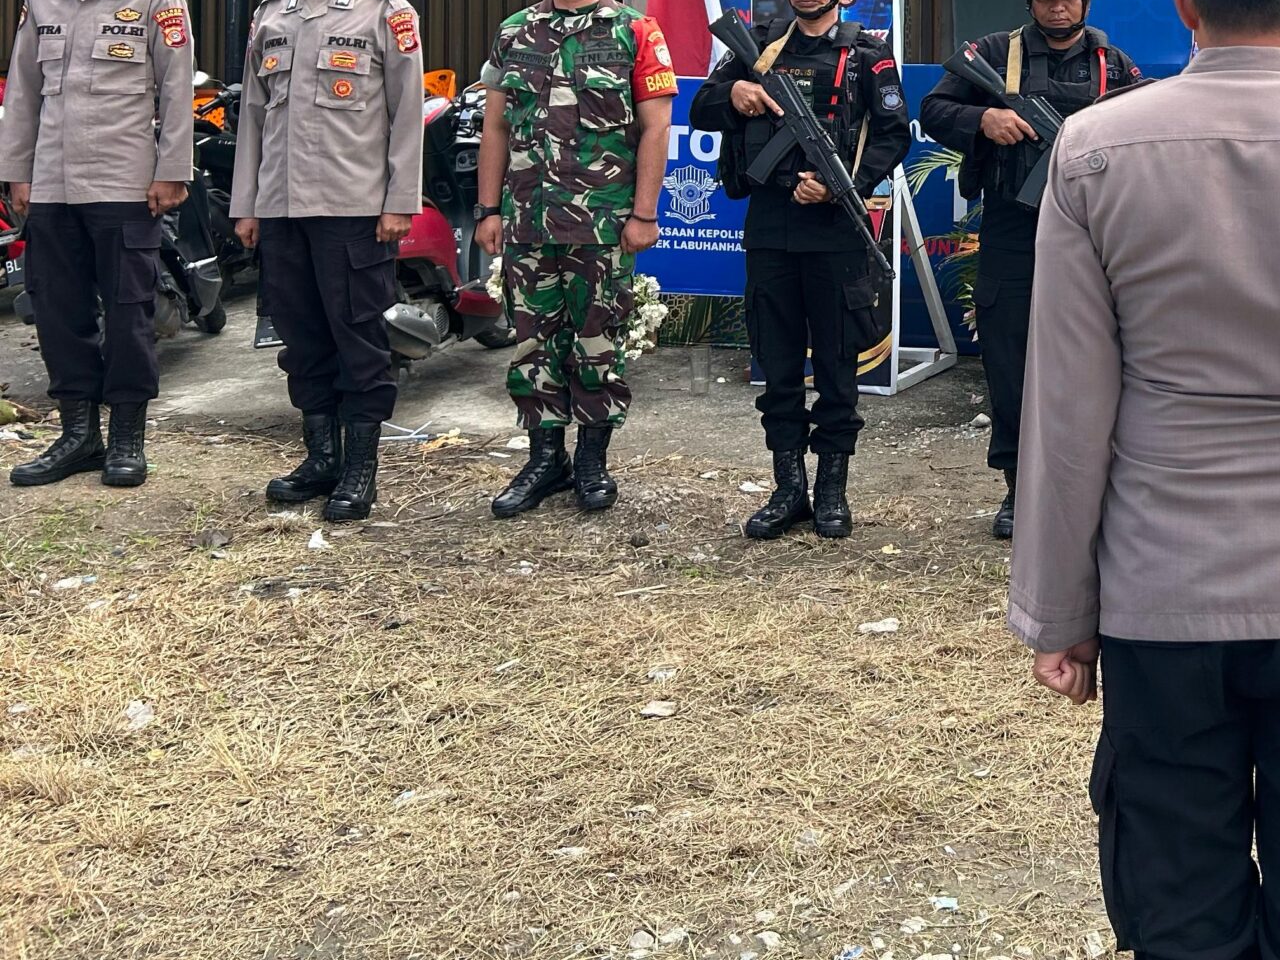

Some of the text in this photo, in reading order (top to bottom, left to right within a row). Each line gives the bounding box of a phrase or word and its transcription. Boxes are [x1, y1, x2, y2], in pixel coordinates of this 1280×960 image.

[101, 25, 144, 37] POLRI
[327, 36, 367, 49] POLRI
[698, 228, 745, 240] KEPOLIS
[674, 241, 746, 252] LABUHANHA
